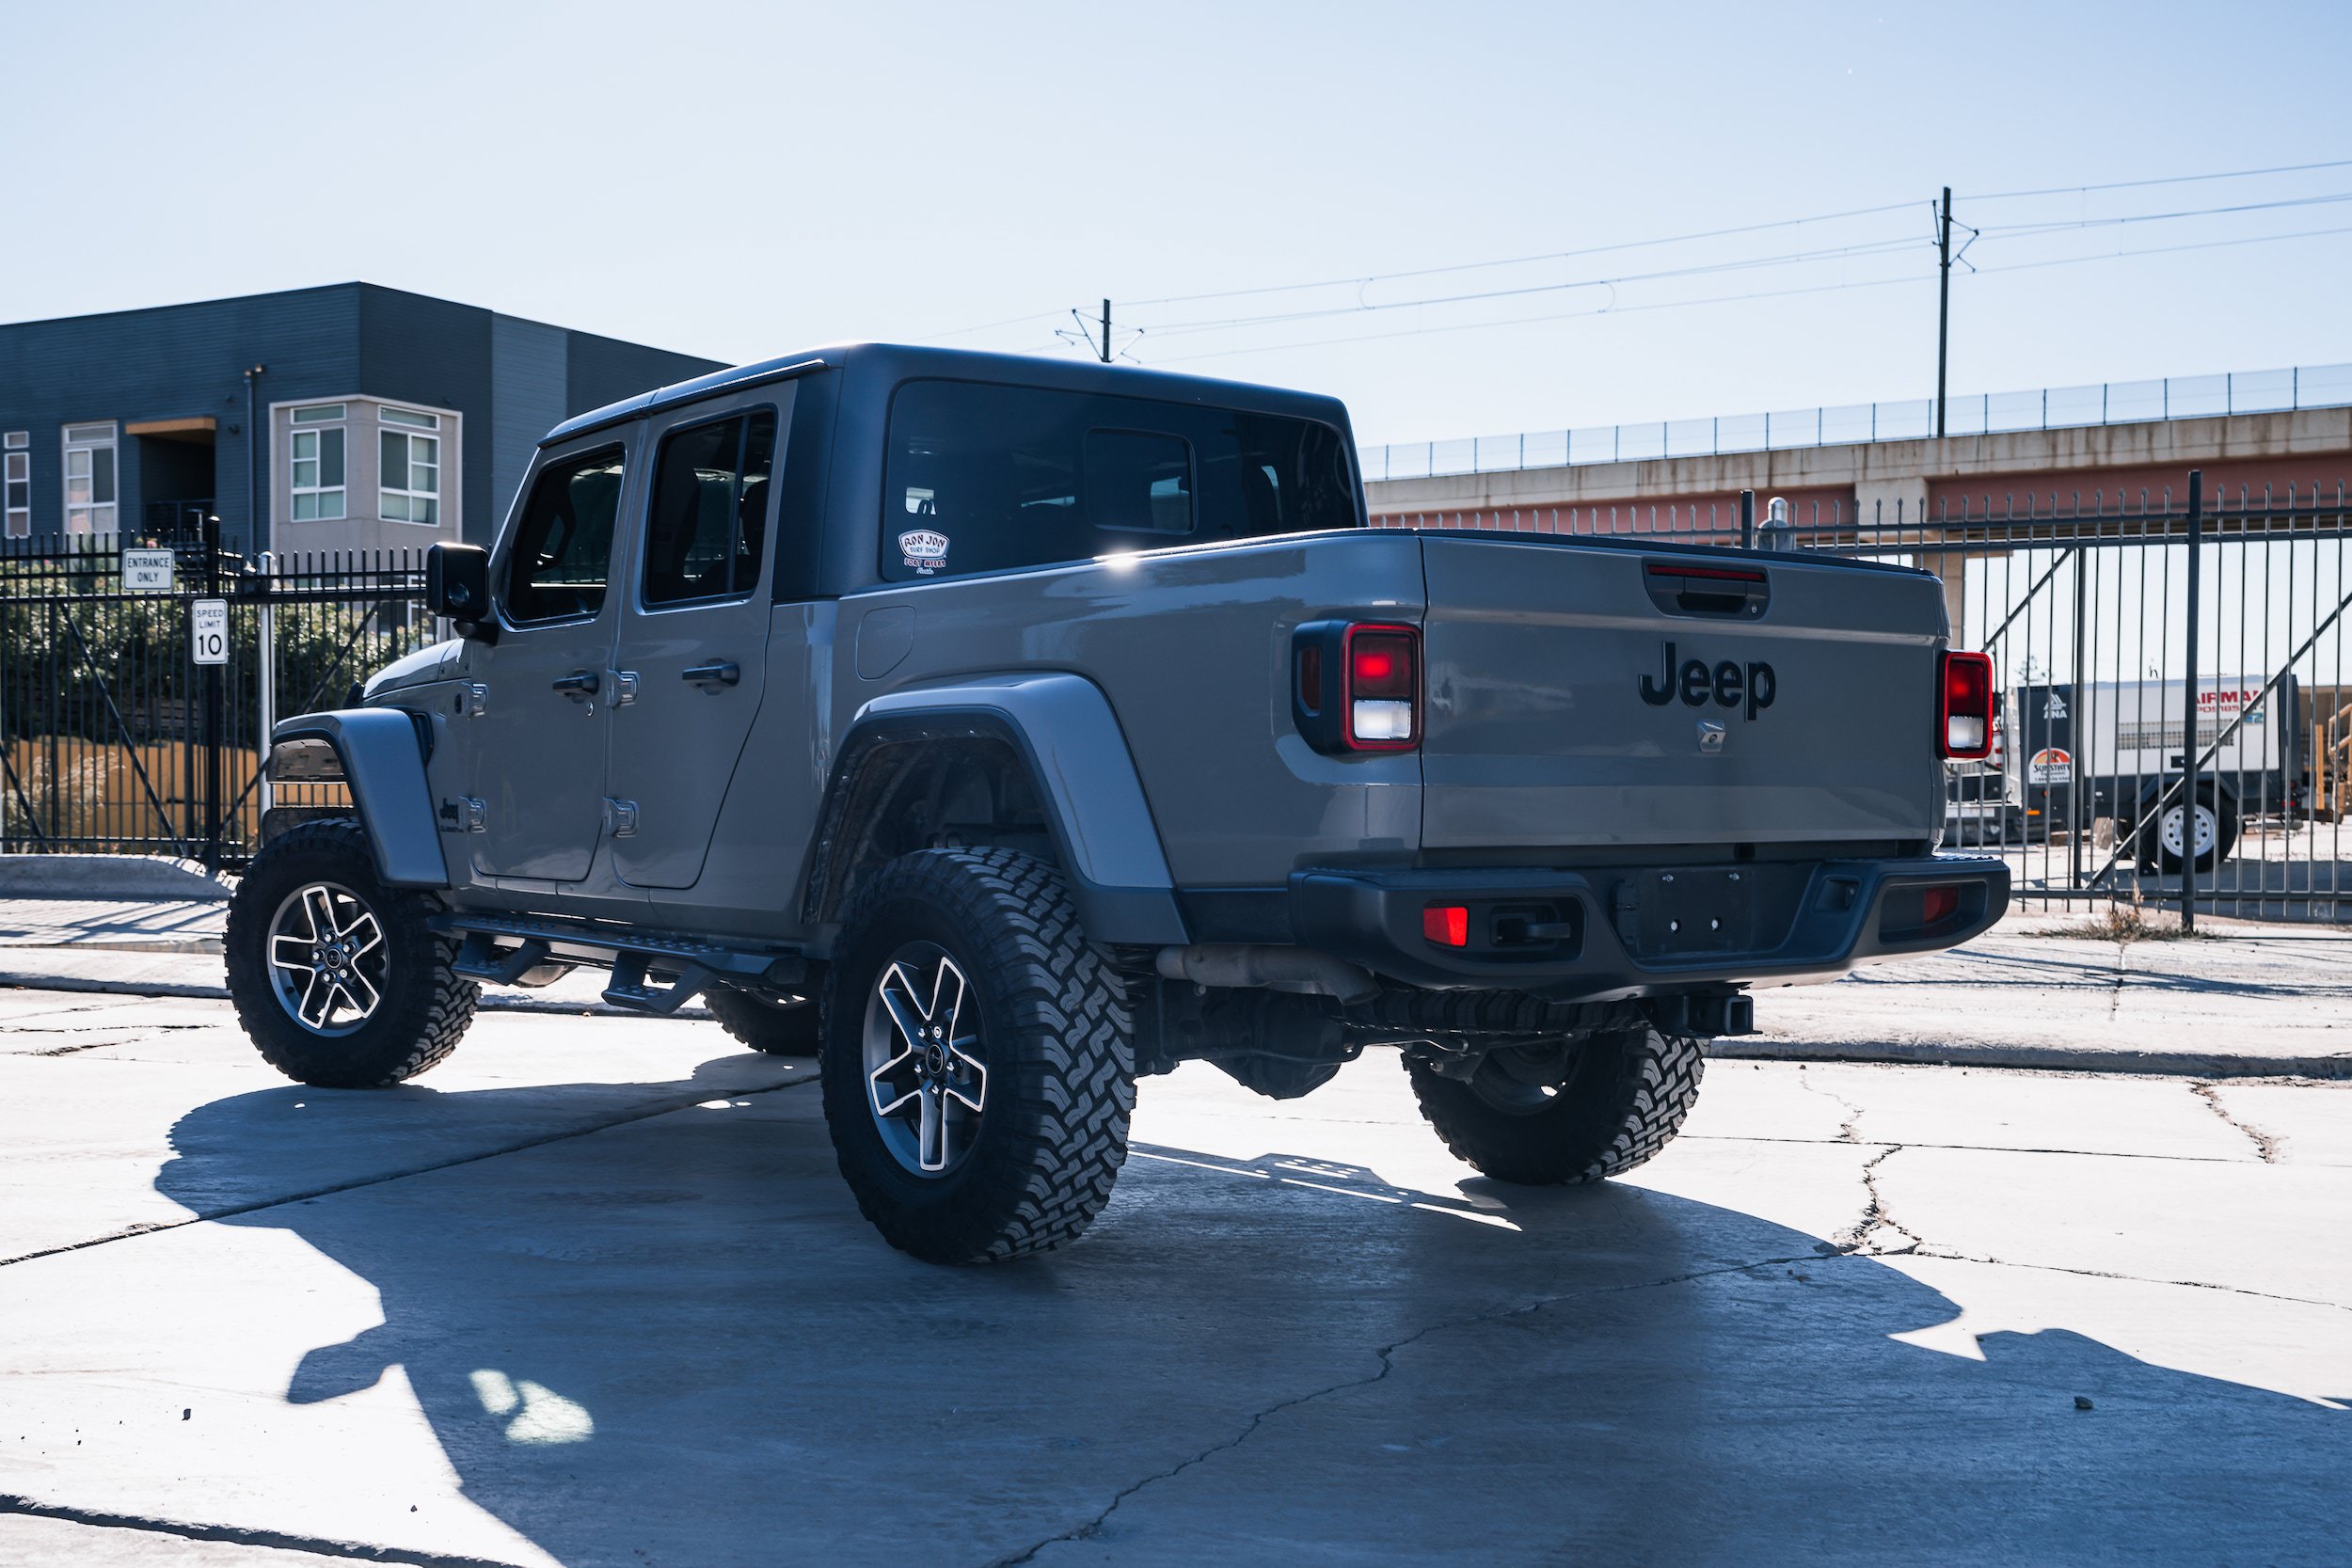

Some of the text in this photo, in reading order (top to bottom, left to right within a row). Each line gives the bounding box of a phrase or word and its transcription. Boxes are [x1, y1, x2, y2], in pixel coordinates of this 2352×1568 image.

[904, 534, 946, 548] RON JON
[127, 557, 170, 568] ENTRANCE
[136, 572, 159, 582] ONLY
[197, 609, 224, 618] SPEED
[199, 620, 221, 629] LIMIT
[199, 633, 222, 656] 10
[1638, 641, 1776, 722] Jeep
